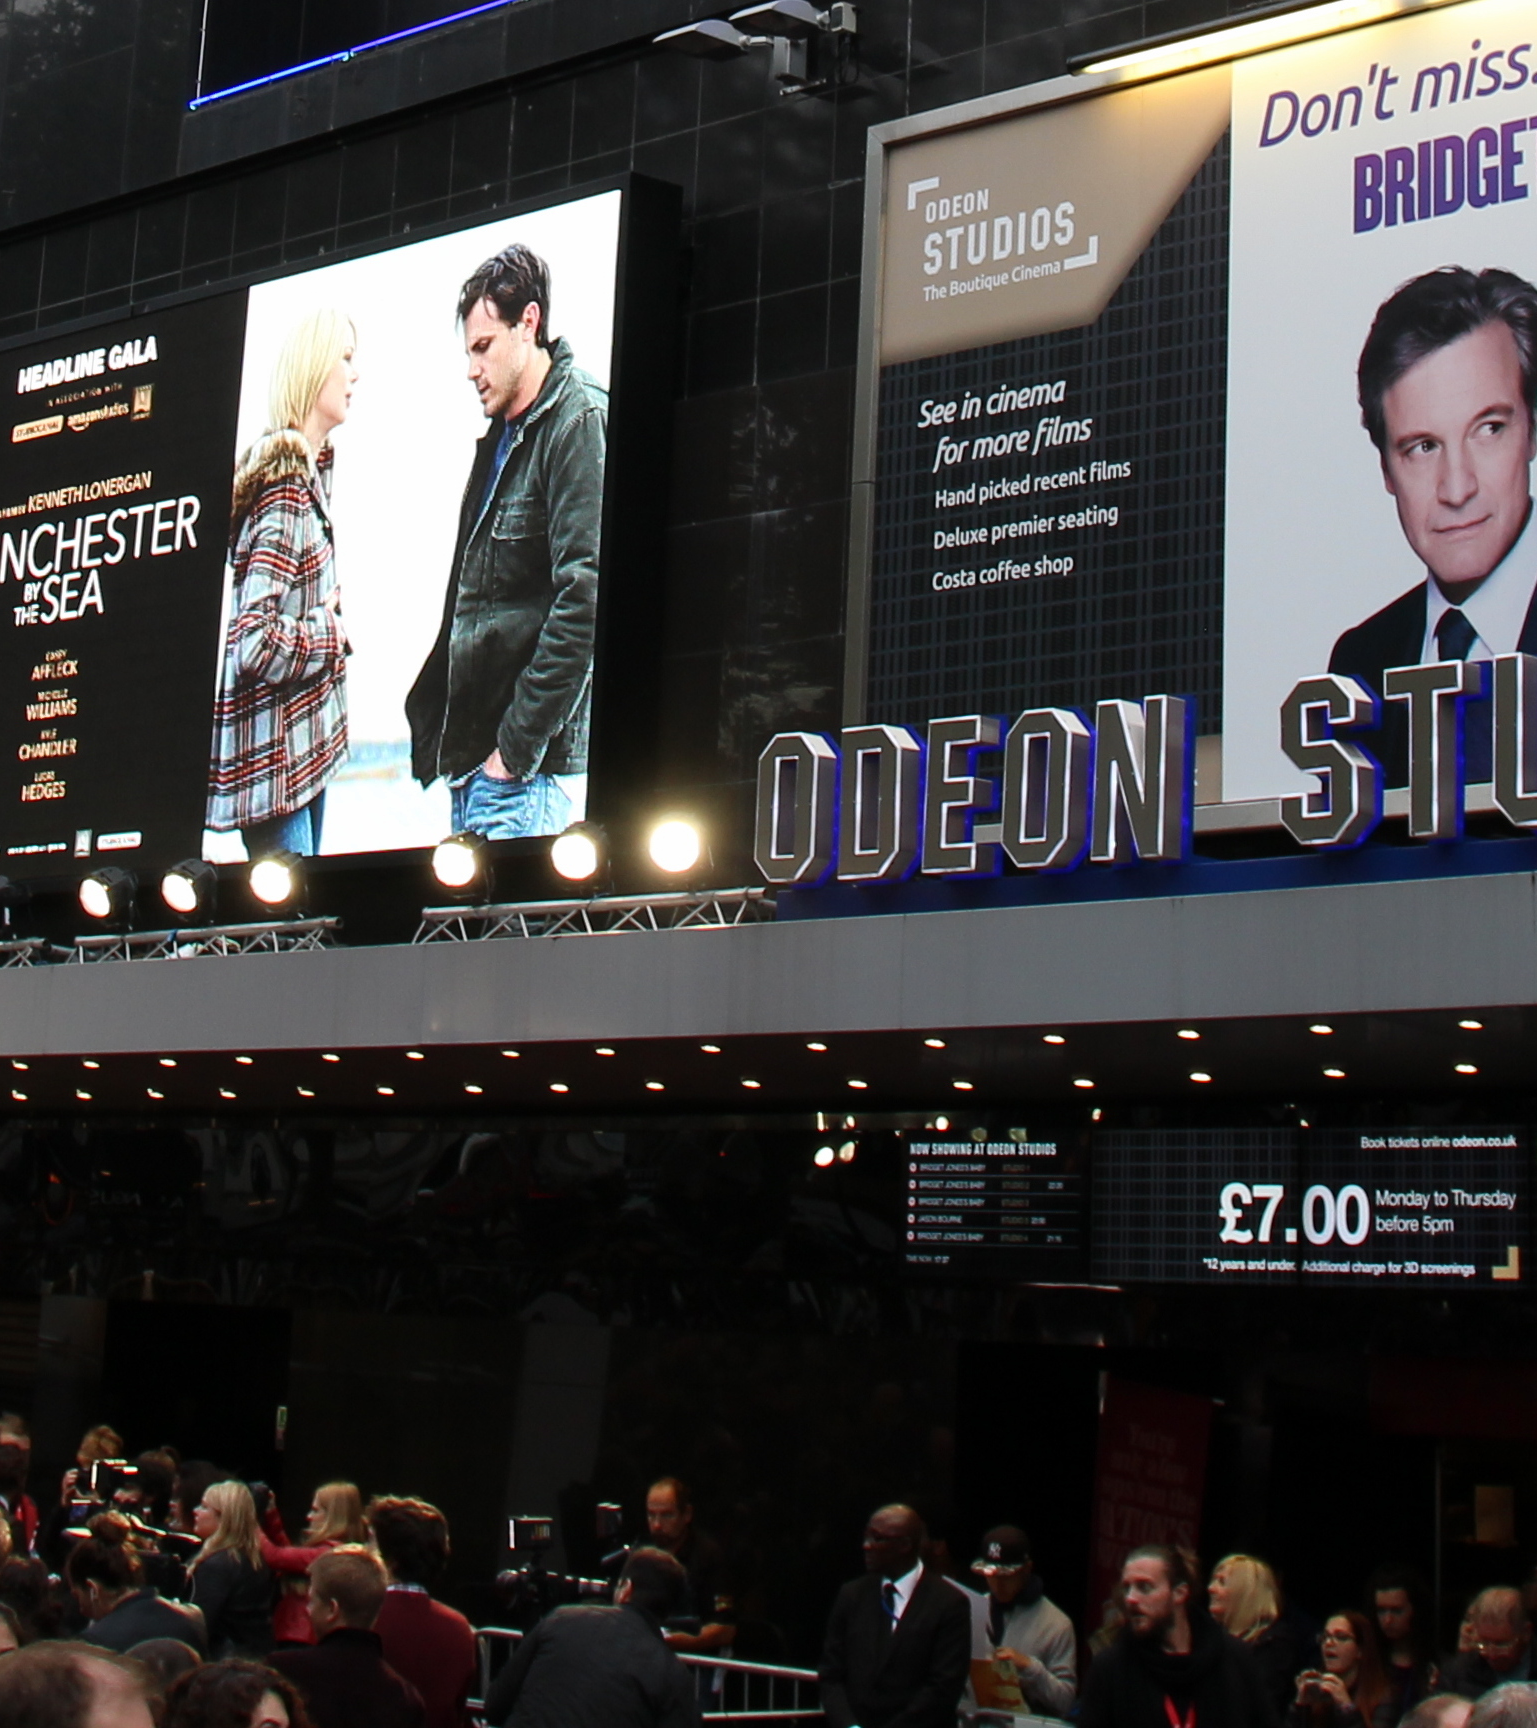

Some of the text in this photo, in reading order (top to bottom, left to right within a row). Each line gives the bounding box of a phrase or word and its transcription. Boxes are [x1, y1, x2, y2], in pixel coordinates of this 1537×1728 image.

[1258, 62, 1399, 148] Don't
[925, 187, 990, 224] ODEON
[922, 200, 1075, 276] STUDIOS
[922, 260, 1062, 303] The Boutique Cinema
[16, 335, 159, 395] HEADLINE GALA
[916, 379, 1067, 429] See in cinema
[932, 414, 1094, 474] for more films
[27, 483, 83, 514] KENNETH
[83, 470, 153, 502] LONERGAN
[935, 459, 1132, 509] Hand picked recent films
[933, 504, 1120, 551] Deluxe premier seating
[931, 554, 1075, 592] Costa coffee shop
[22, 581, 43, 604] BY
[39, 568, 105, 625] SEA
[13, 603, 41, 628] THE
[30, 659, 79, 682] AFFLECK
[25, 697, 79, 722] WILLIAMS
[17, 737, 78, 762] CHANDLER
[20, 780, 67, 802] HEDGES
[752, 692, 1194, 885] ODEON
[909, 1142, 1058, 1157] NOW SHOWING AT ODEON STUDIOS
[1360, 1135, 1517, 1149] Book tickets online odeon.co.uk
[1218, 1181, 1371, 1246] £7.00
[1374, 1188, 1517, 1211] Monday to Thursday
[1374, 1215, 1455, 1235] before 5pm
[1301, 1260, 1476, 1277] Additional charge for 3D screenings
